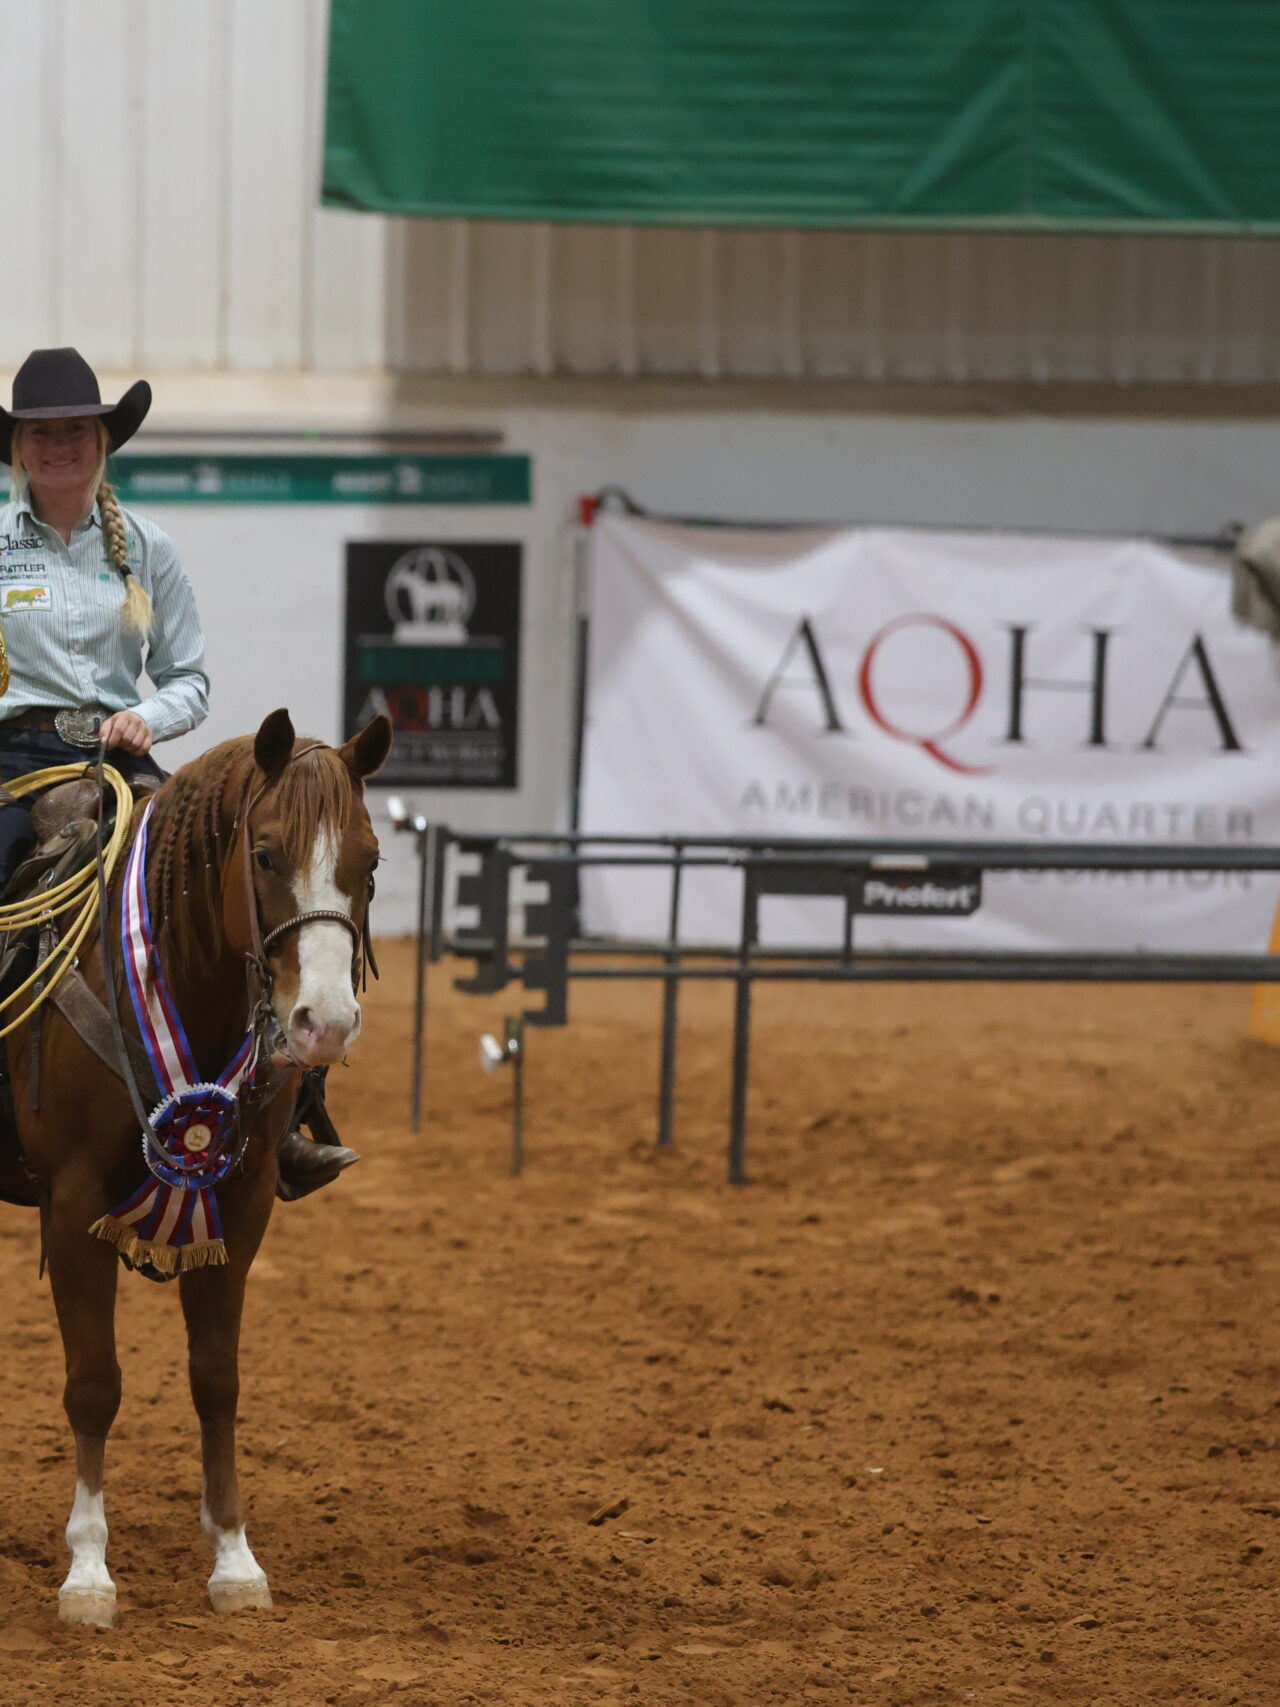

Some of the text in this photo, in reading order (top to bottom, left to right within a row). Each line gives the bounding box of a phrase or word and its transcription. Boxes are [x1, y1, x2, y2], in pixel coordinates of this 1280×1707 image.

[0, 564, 46, 573] RATTLER
[357, 686, 502, 733] AQHA
[747, 611, 1249, 777] AQHA
[737, 781, 1255, 839] AMERICAN QUARTER
[864, 881, 971, 909] Priefert
